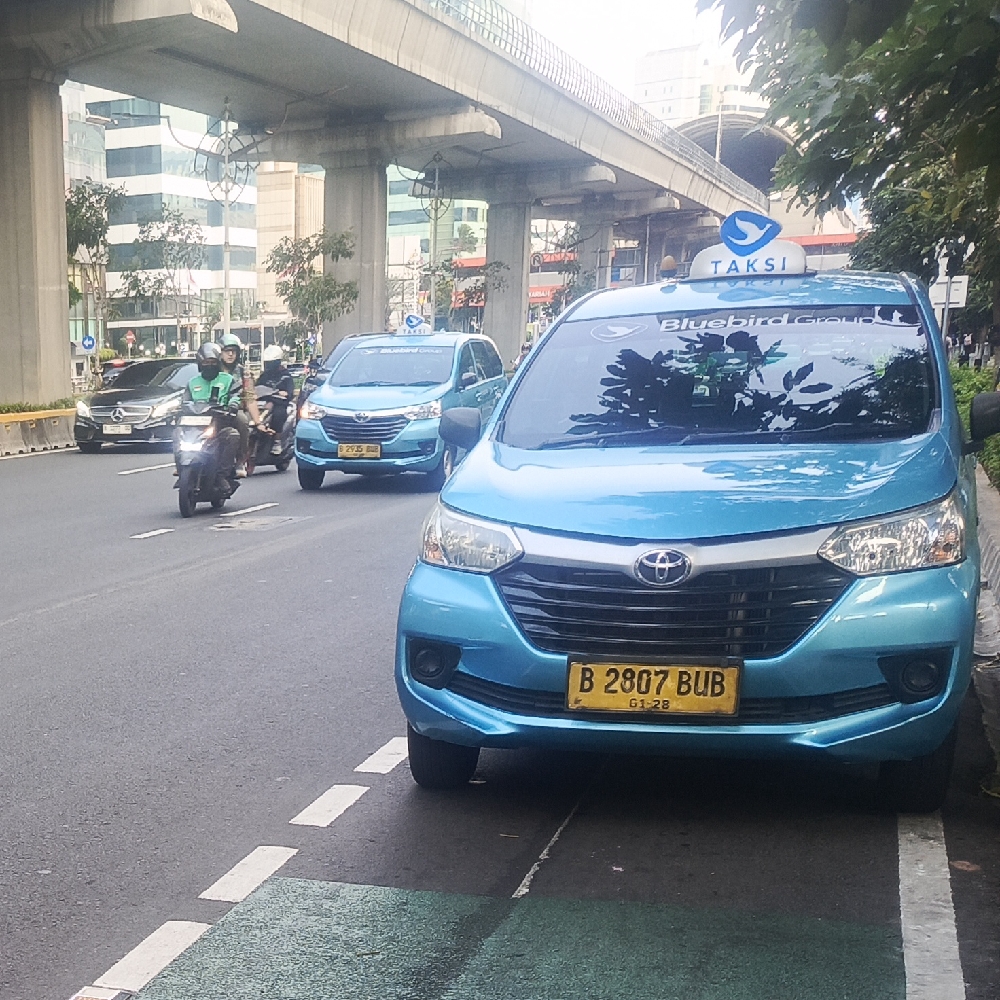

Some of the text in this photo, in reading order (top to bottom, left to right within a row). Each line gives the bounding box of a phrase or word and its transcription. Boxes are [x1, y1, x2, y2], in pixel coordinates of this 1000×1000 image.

[711, 257, 787, 275] TAKSI
[659, 313, 875, 332] Bluebird Group
[579, 667, 726, 697] B 2807 BUB
